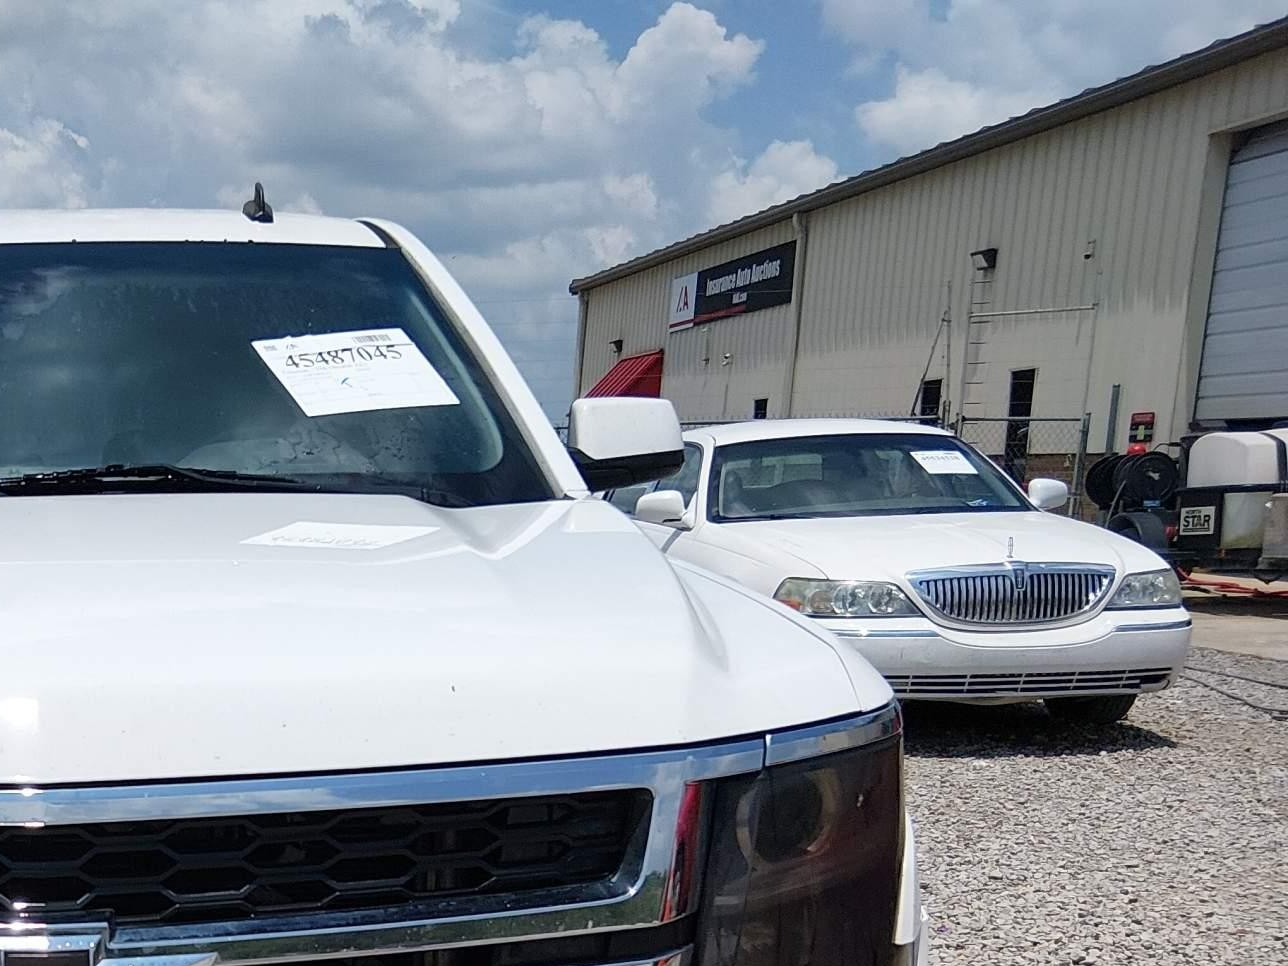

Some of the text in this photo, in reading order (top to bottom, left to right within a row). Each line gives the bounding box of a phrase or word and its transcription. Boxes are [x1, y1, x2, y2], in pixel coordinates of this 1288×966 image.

[706, 259, 781, 297] Insurance Auto Auctions
[284, 345, 403, 369] 45487045
[1183, 514, 1211, 528] STAR
